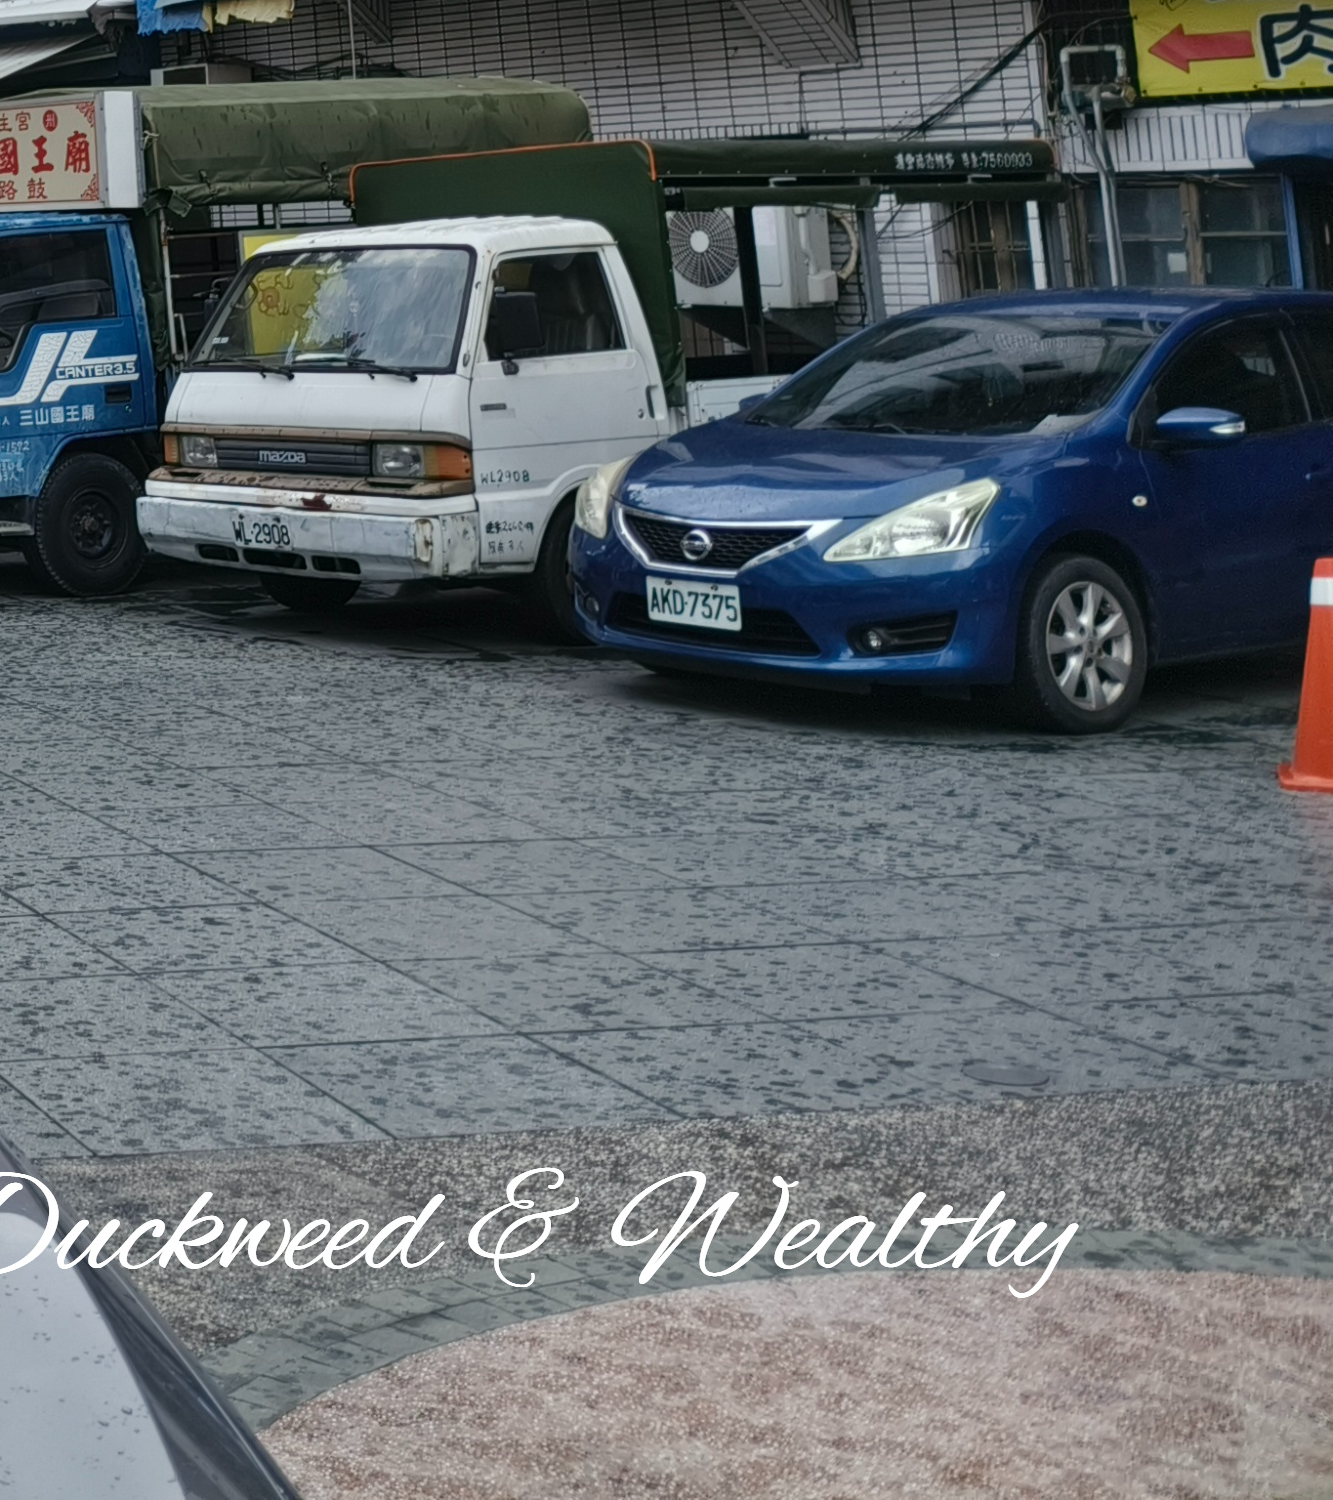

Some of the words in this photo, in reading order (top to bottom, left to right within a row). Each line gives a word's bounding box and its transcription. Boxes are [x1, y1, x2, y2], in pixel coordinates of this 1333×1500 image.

[19, 404, 95, 426] 三山國王廟
